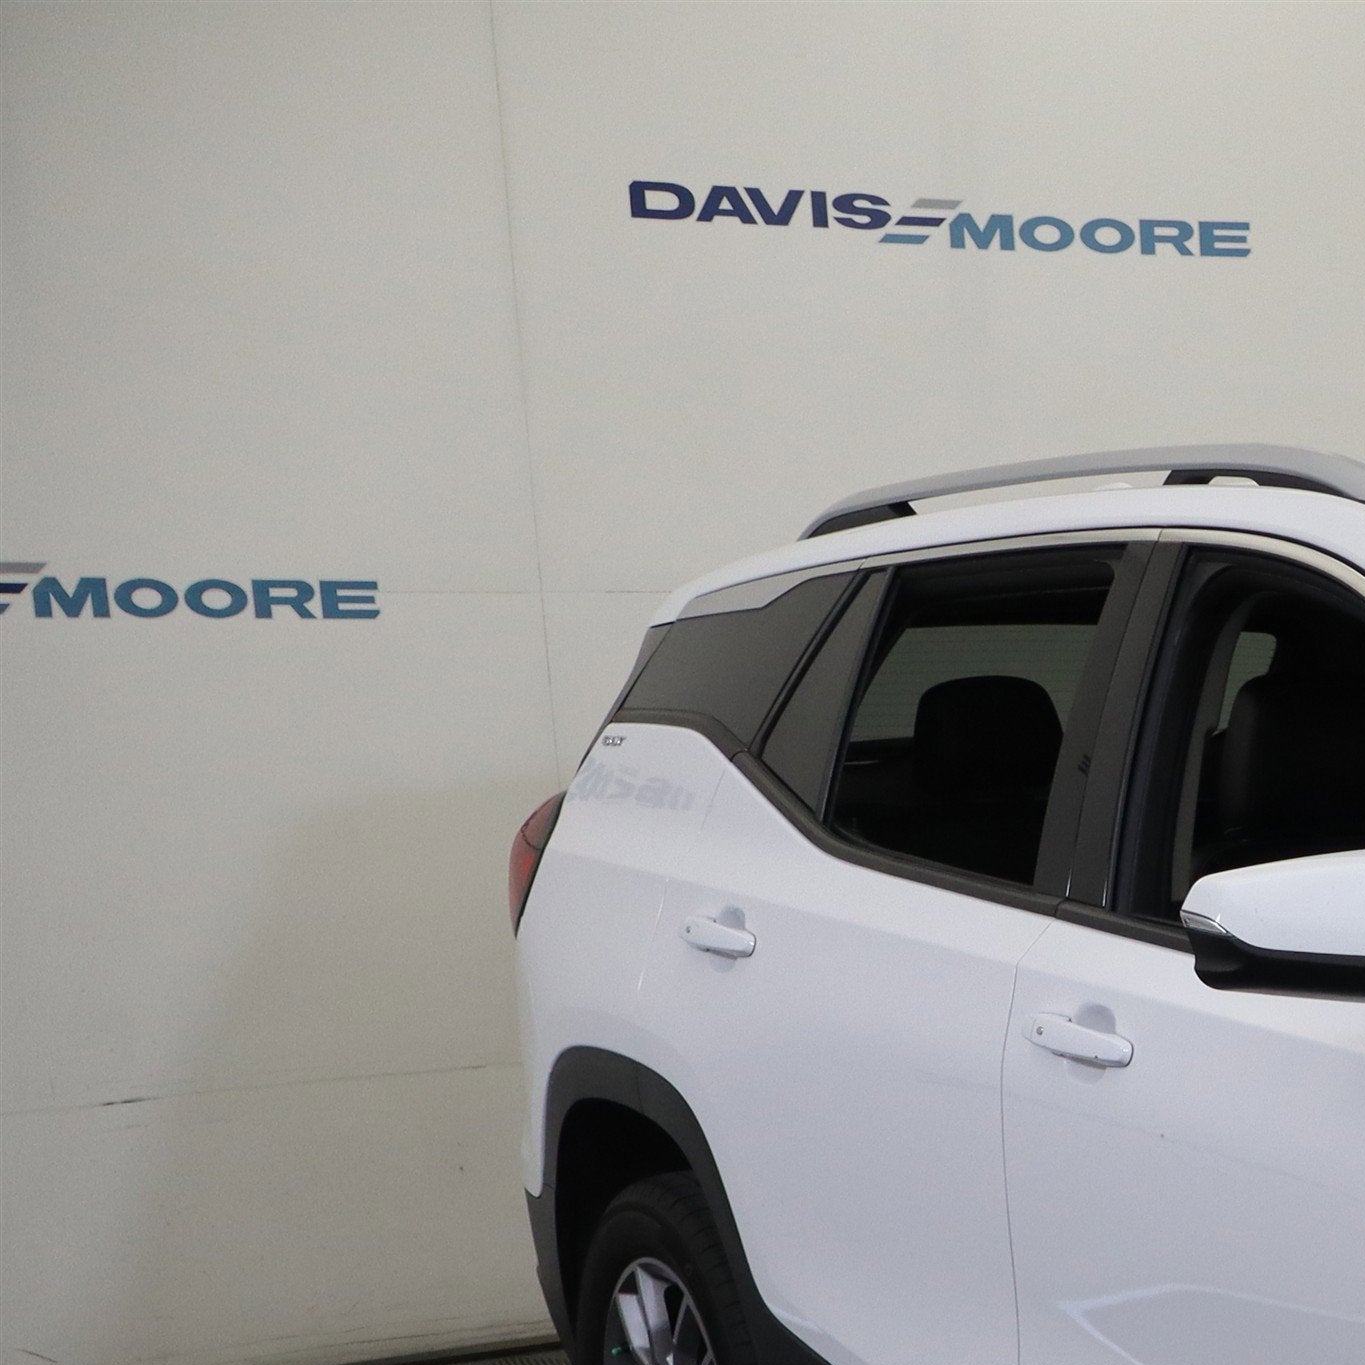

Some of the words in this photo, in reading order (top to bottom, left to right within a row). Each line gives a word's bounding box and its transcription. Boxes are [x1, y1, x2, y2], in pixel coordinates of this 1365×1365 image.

[628, 180, 892, 229] DAVIS
[950, 212, 1252, 258] MOORE
[33, 576, 381, 620] MOORE
